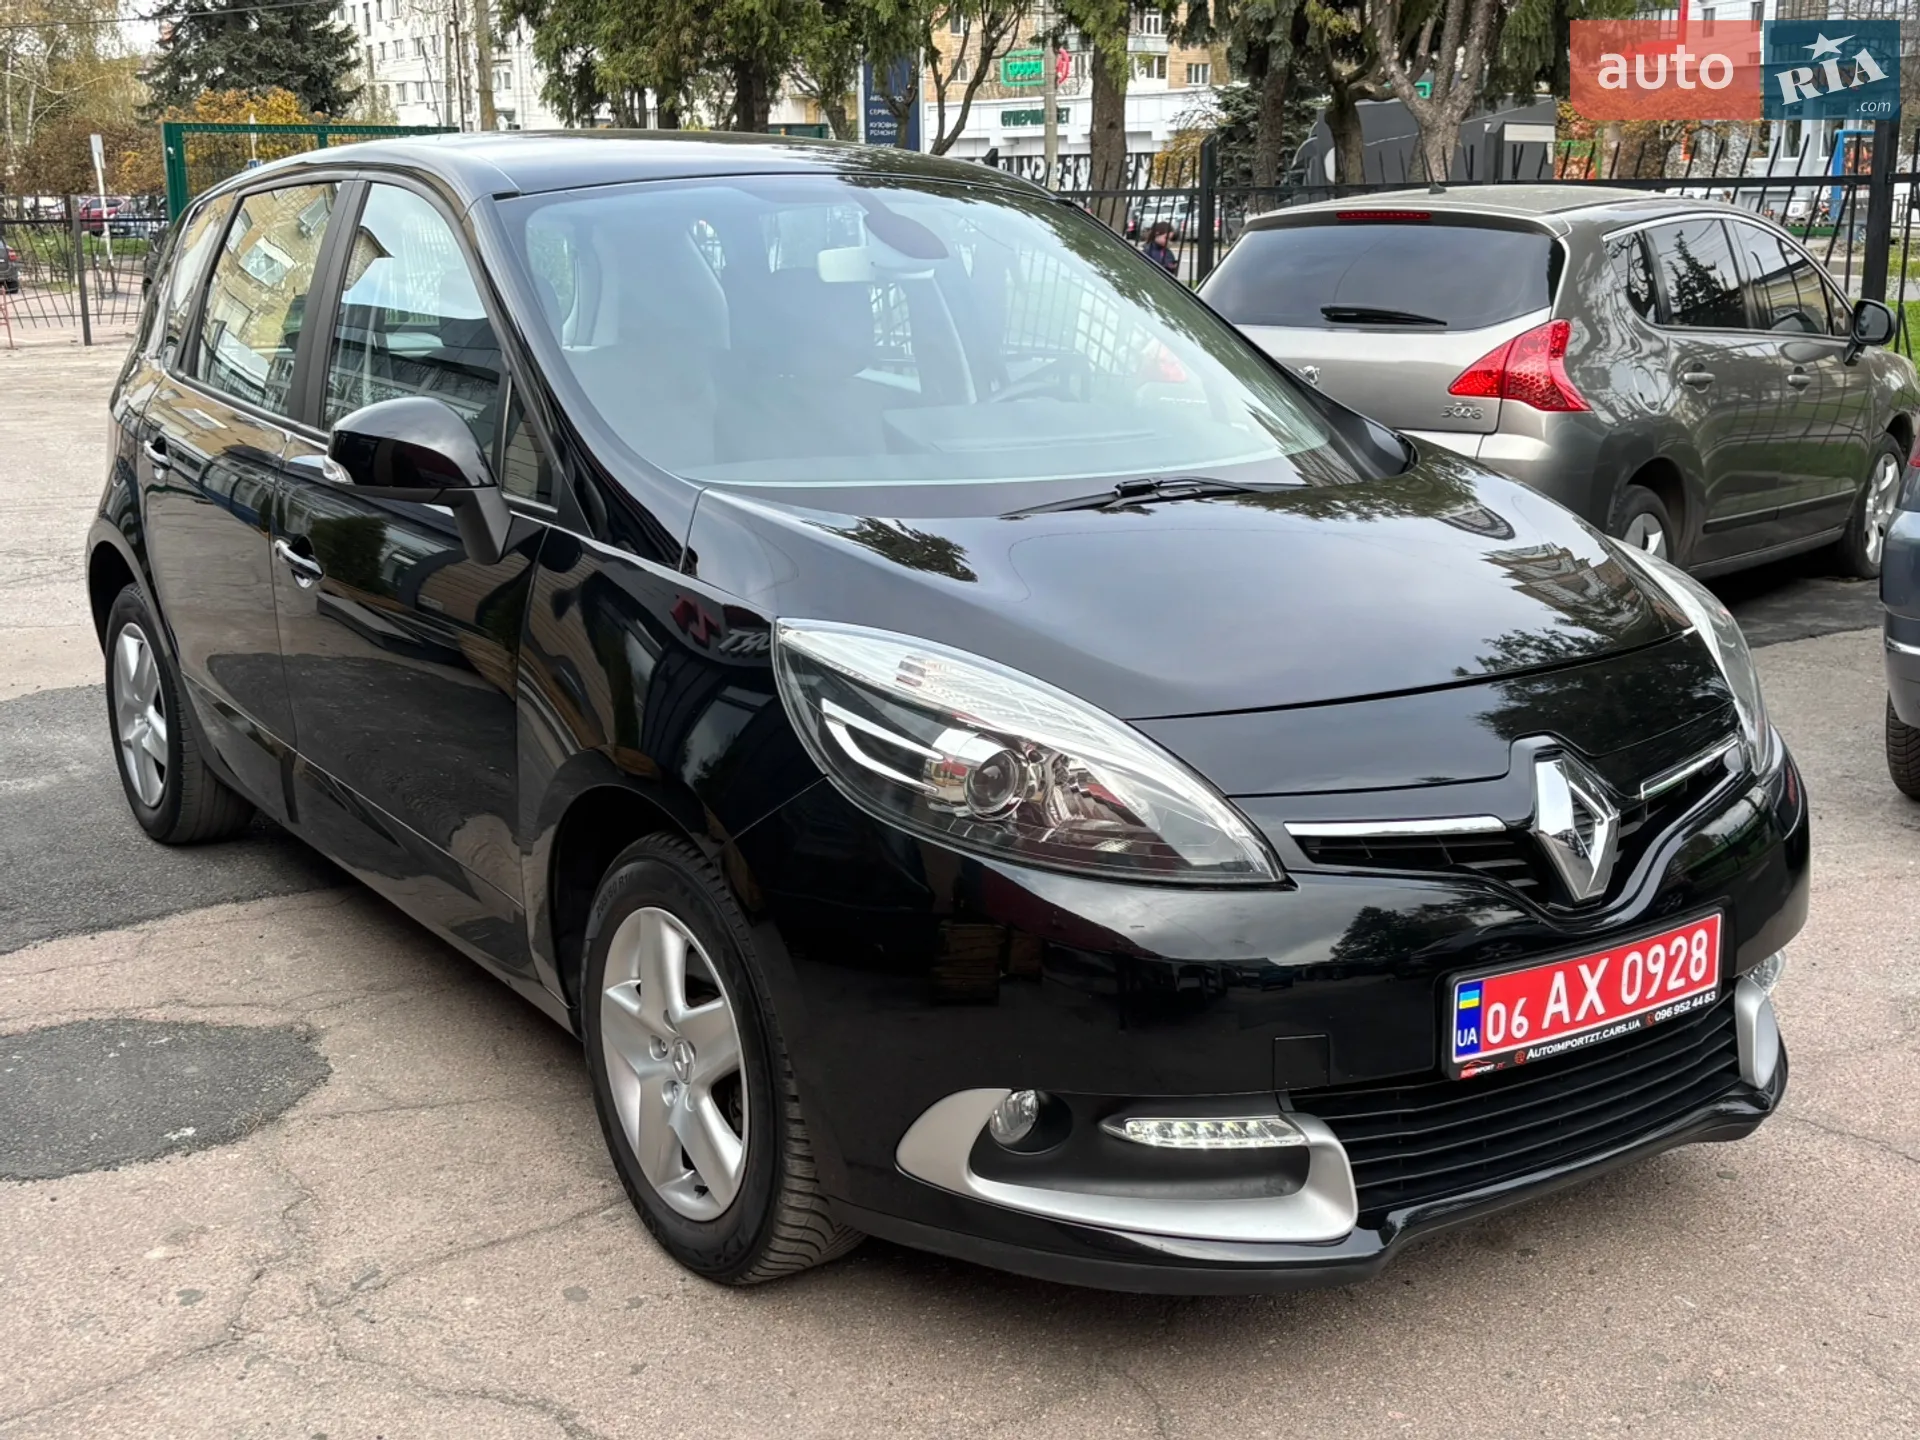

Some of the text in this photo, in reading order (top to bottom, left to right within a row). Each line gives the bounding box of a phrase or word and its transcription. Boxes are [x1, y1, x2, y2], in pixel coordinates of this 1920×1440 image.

[1485, 928, 1709, 1045] 06 AX 0928
[1654, 1006, 1673, 1022] 096
[1673, 1000, 1691, 1015] 952
[1457, 1027, 1478, 1047] UA
